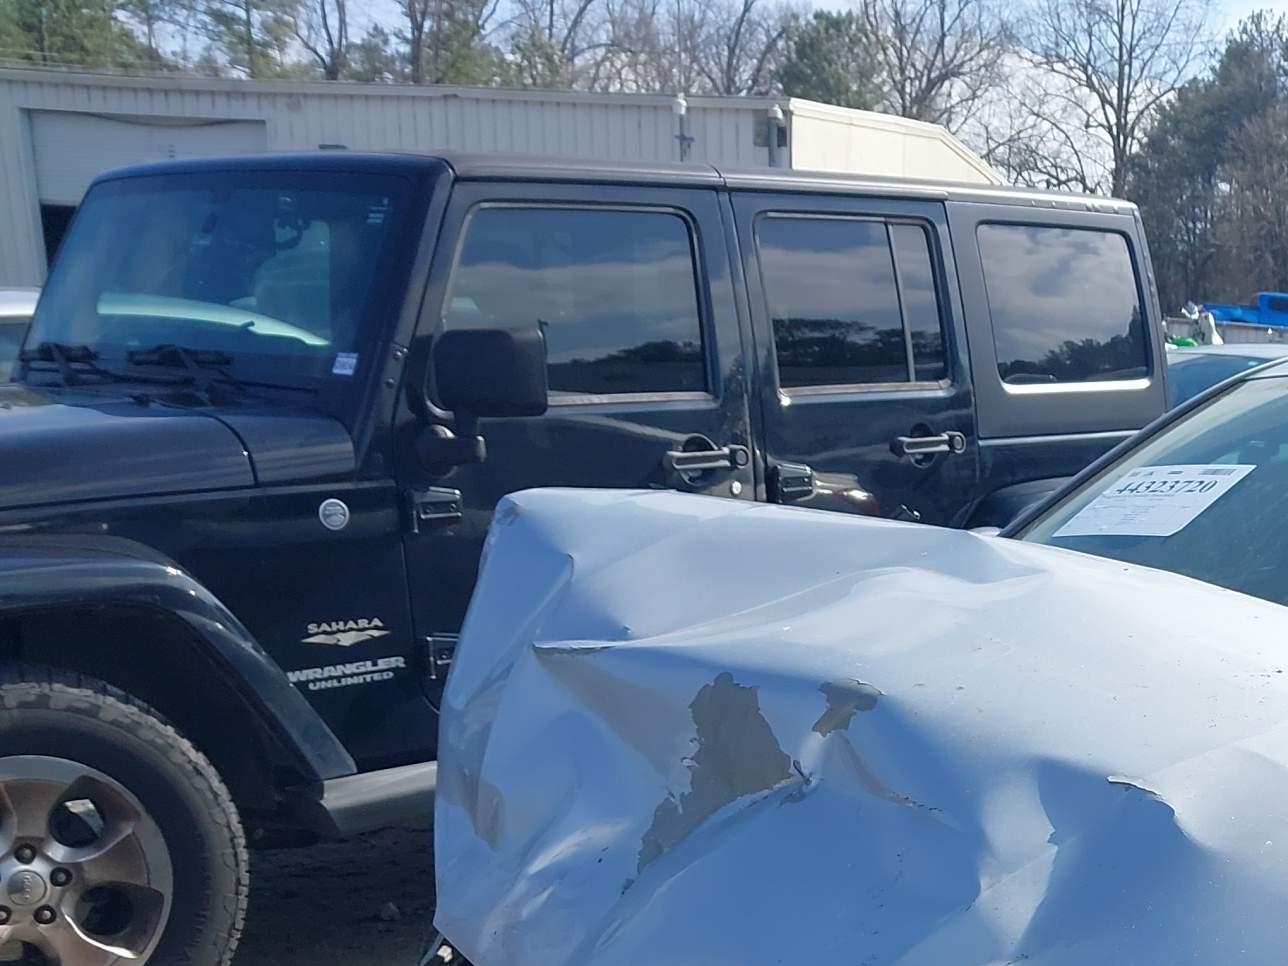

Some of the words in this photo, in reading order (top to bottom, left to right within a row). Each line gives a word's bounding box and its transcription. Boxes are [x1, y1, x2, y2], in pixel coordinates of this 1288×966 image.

[1115, 480, 1218, 494] 44323720
[306, 616, 385, 634] SAHARA
[286, 655, 407, 683] WRANGLER
[307, 670, 395, 691] UNLIMITED
